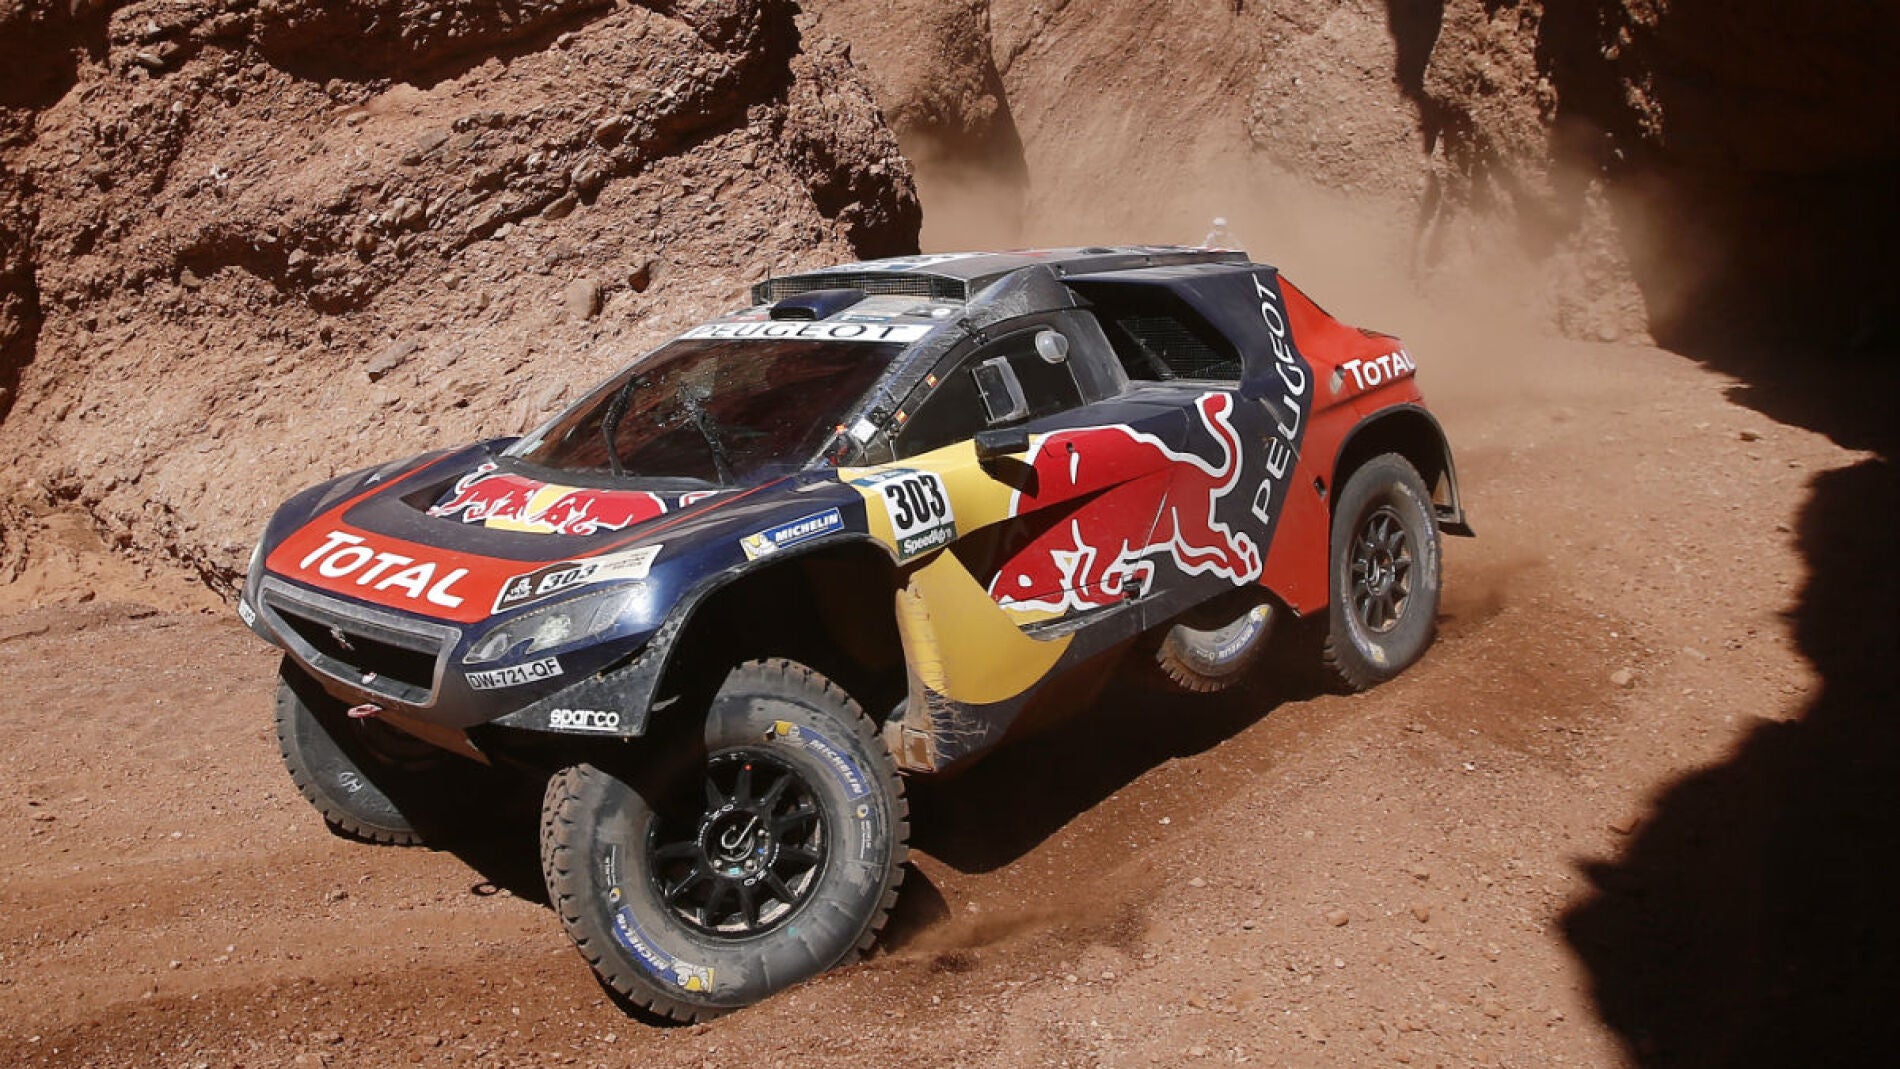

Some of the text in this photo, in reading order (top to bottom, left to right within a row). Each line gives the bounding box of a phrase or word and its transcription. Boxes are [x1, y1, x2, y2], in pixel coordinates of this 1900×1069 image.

[691, 323, 909, 340] PEUGEOT
[1342, 349, 1416, 390] TOTAL
[1251, 273, 1305, 524] PEUGEOT
[885, 474, 946, 529] 303
[775, 512, 839, 543] MICHELIN
[299, 530, 470, 608] TOTAL
[543, 564, 598, 590] 303
[469, 660, 558, 688] DW-721-QF
[549, 708, 620, 731] sparco
[809, 739, 862, 794] MICHELIN
[616, 913, 668, 970] MICHELIN
